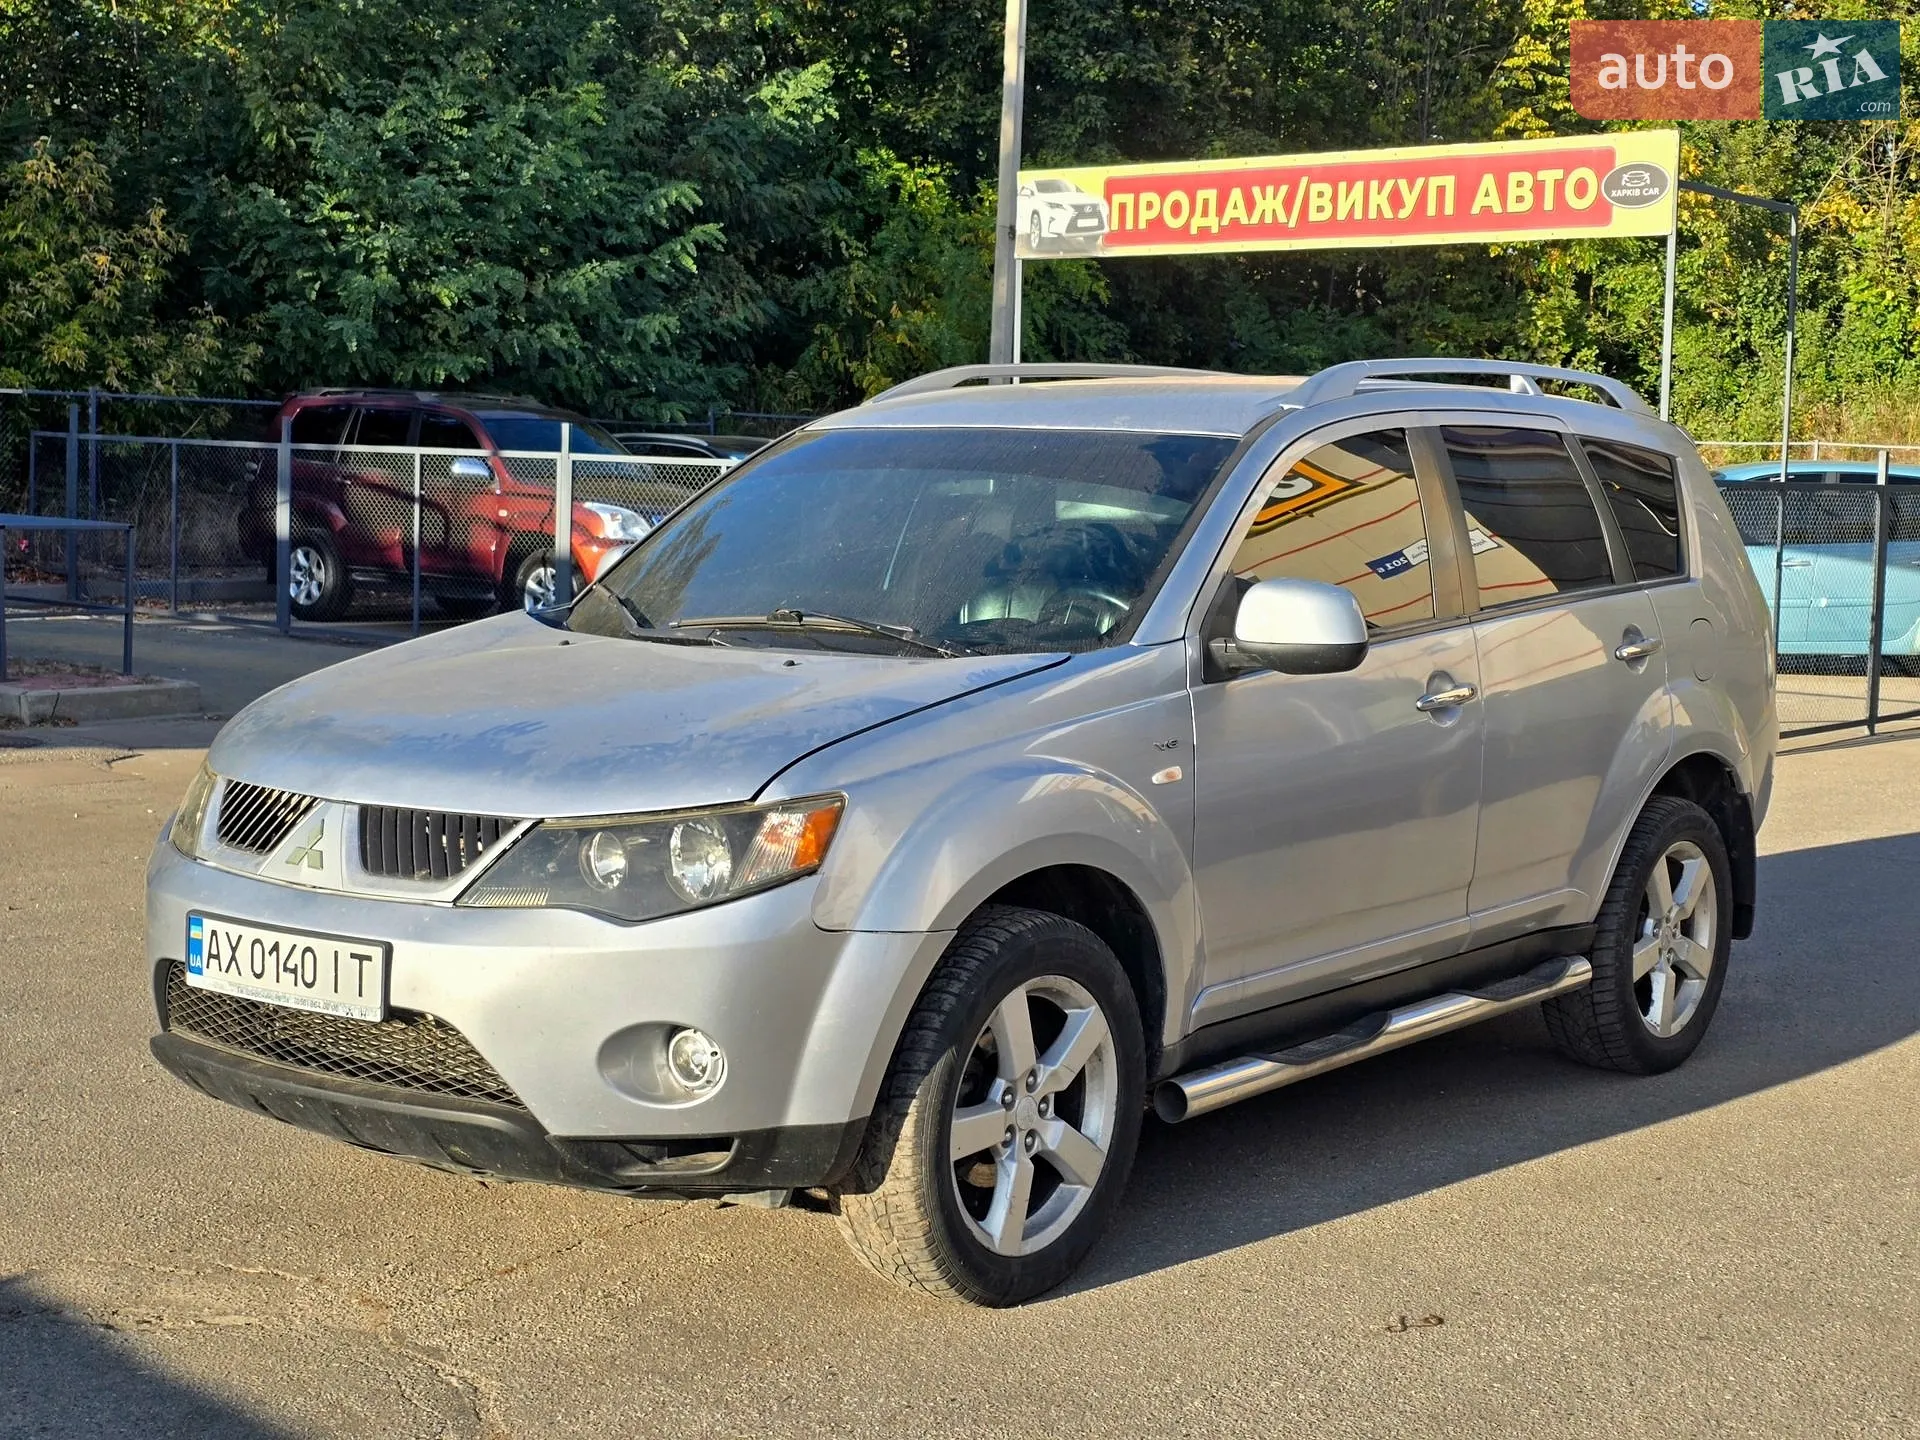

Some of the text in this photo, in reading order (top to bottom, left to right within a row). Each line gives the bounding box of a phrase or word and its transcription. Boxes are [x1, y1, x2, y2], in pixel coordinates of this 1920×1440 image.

[1110, 166, 1598, 235] ПРОДАЖ/ВИКУП АВТО
[1611, 187, 1660, 197] ХАРКІВ CAR
[190, 953, 202, 969] UA
[206, 929, 373, 998] AX 0140 IT
